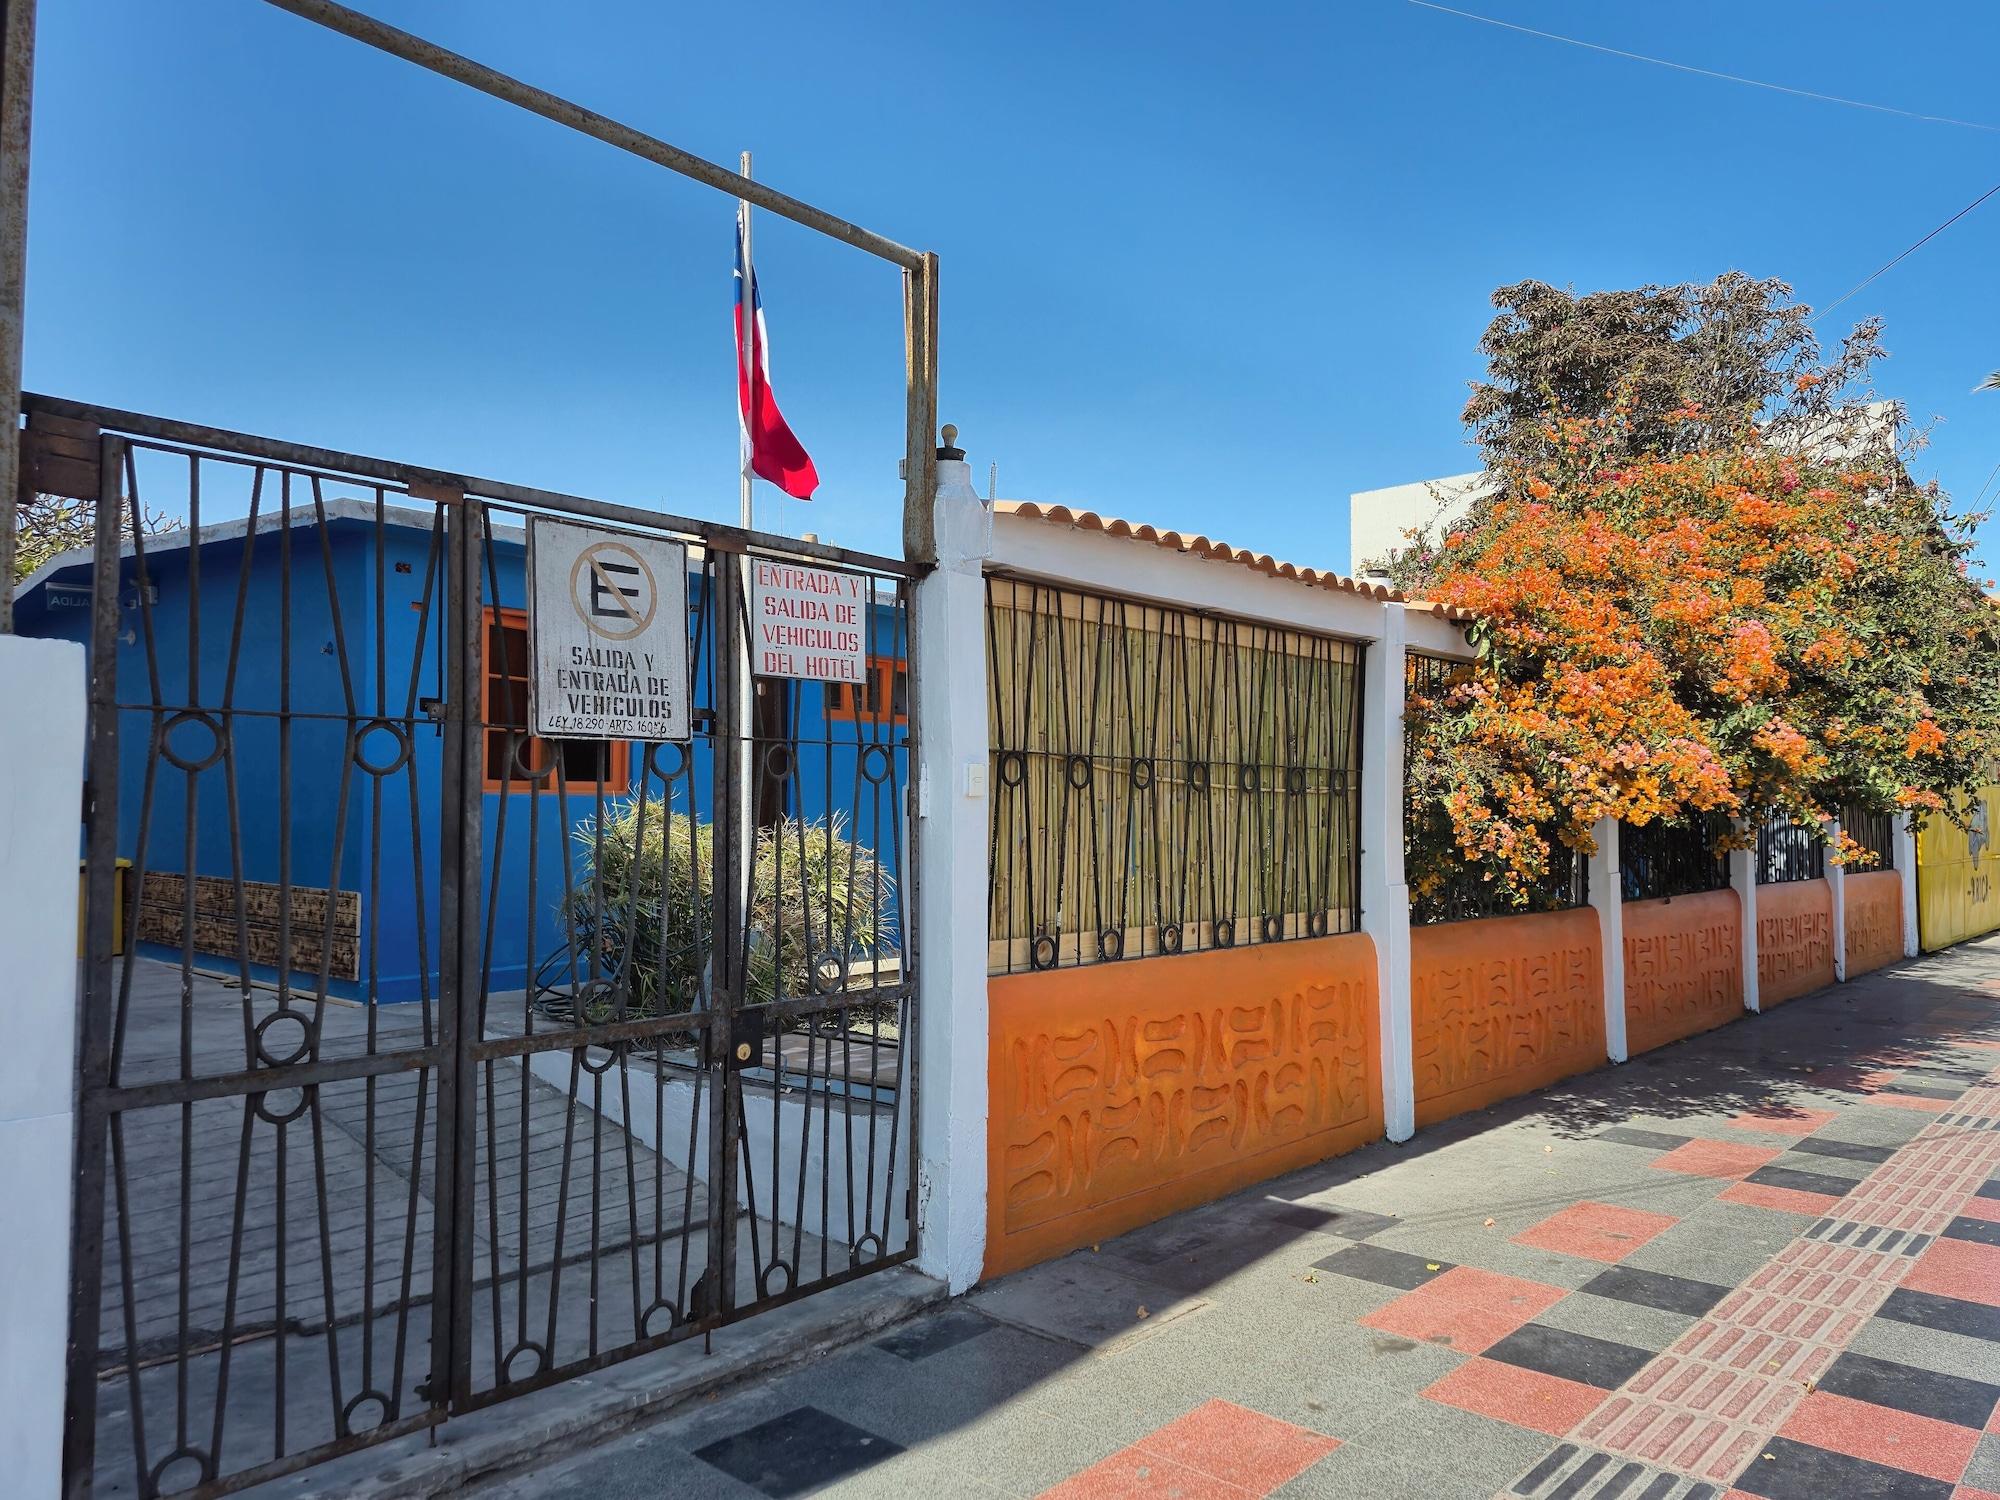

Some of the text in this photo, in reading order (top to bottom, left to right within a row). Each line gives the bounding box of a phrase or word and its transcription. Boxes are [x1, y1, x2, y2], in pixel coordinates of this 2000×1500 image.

[758, 564, 859, 598] ENTRADA Y
[764, 596, 857, 625] SALIDA DE
[762, 623, 859, 652] VEHICULOS
[572, 646, 654, 672] SALIDA Y
[764, 652, 860, 680] DEL HOTEL
[557, 669, 669, 697] ENTRADA DE
[567, 693, 672, 719] VEHICULOS
[548, 715, 569, 728] LEY
